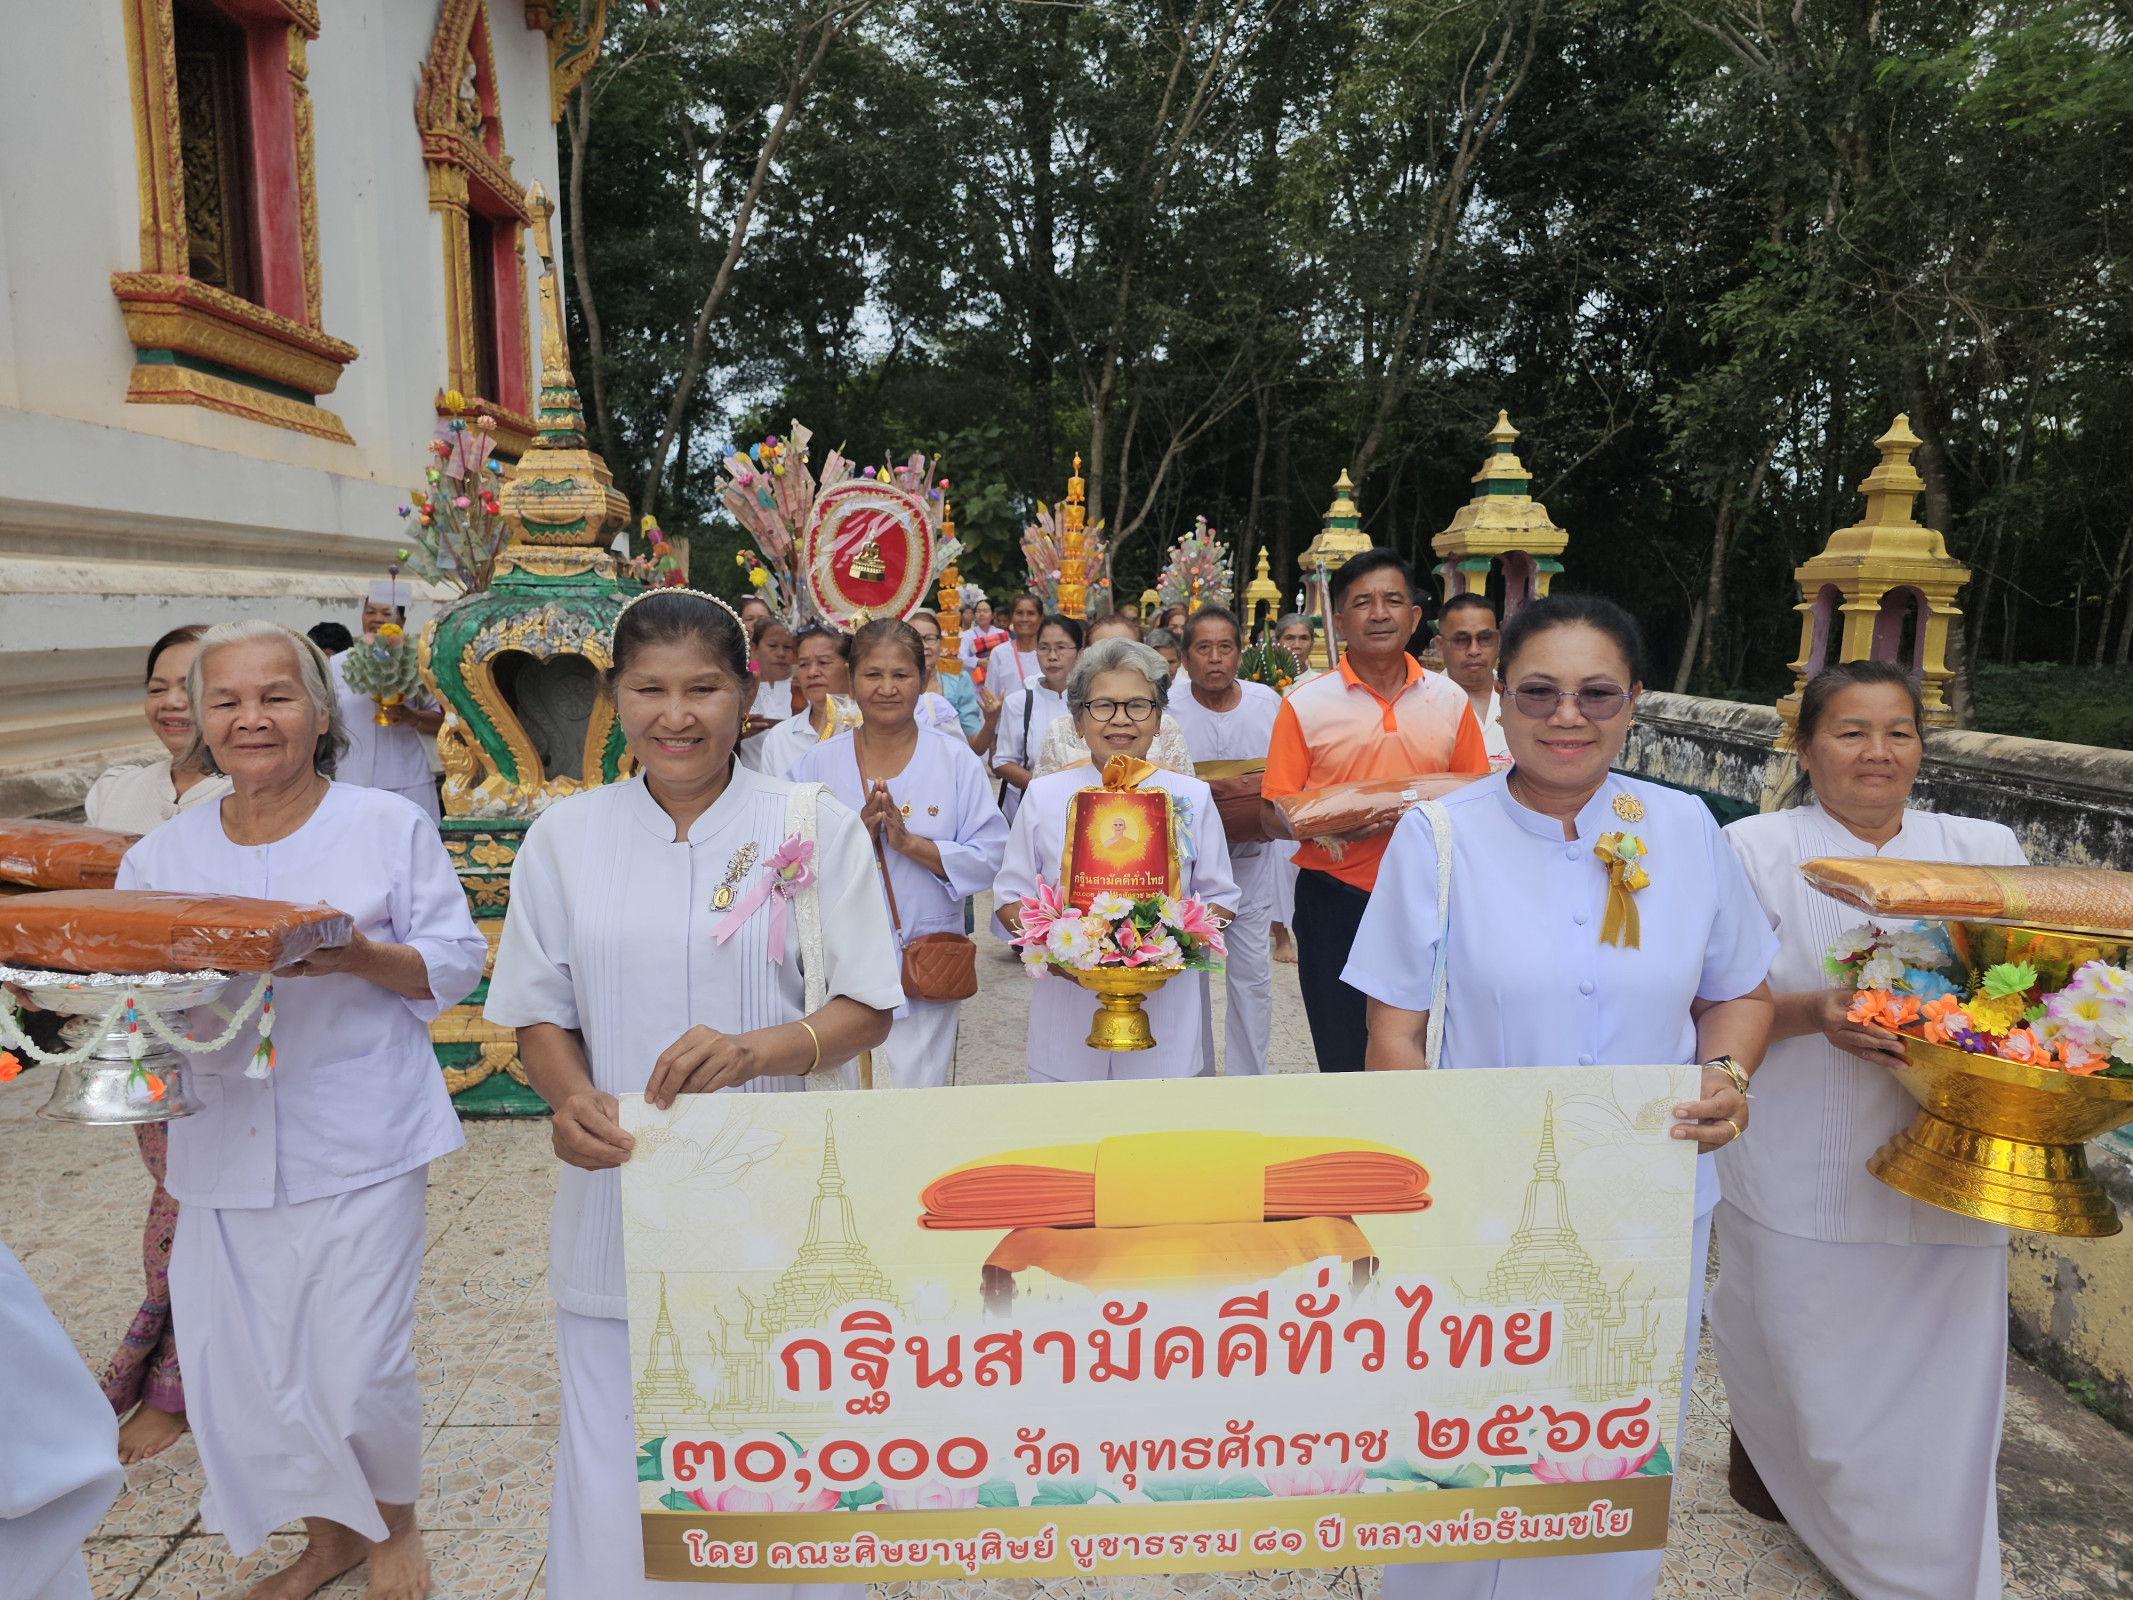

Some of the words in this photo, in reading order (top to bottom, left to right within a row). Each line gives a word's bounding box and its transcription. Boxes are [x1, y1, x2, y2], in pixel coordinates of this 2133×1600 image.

[780, 1267, 1552, 1415] กฐินสามัคคีทั่วไทย
[672, 1437, 988, 1493] ๓๐,๐๐๐
[1014, 1427, 1080, 1476] วัด
[1099, 1419, 1389, 1491] พุทธศักราช
[1414, 1397, 1651, 1460] ๒๕๖๘
[687, 1533, 754, 1564] โดย
[771, 1527, 1054, 1571] คณะศิษยานุศิษย์
[1071, 1533, 1238, 1568] บูชาธรรม
[1253, 1530, 1303, 1552] ๘๑
[1318, 1517, 1342, 1548] ปี
[1357, 1503, 1630, 1546] หลวงพ่อธัมมชโย
